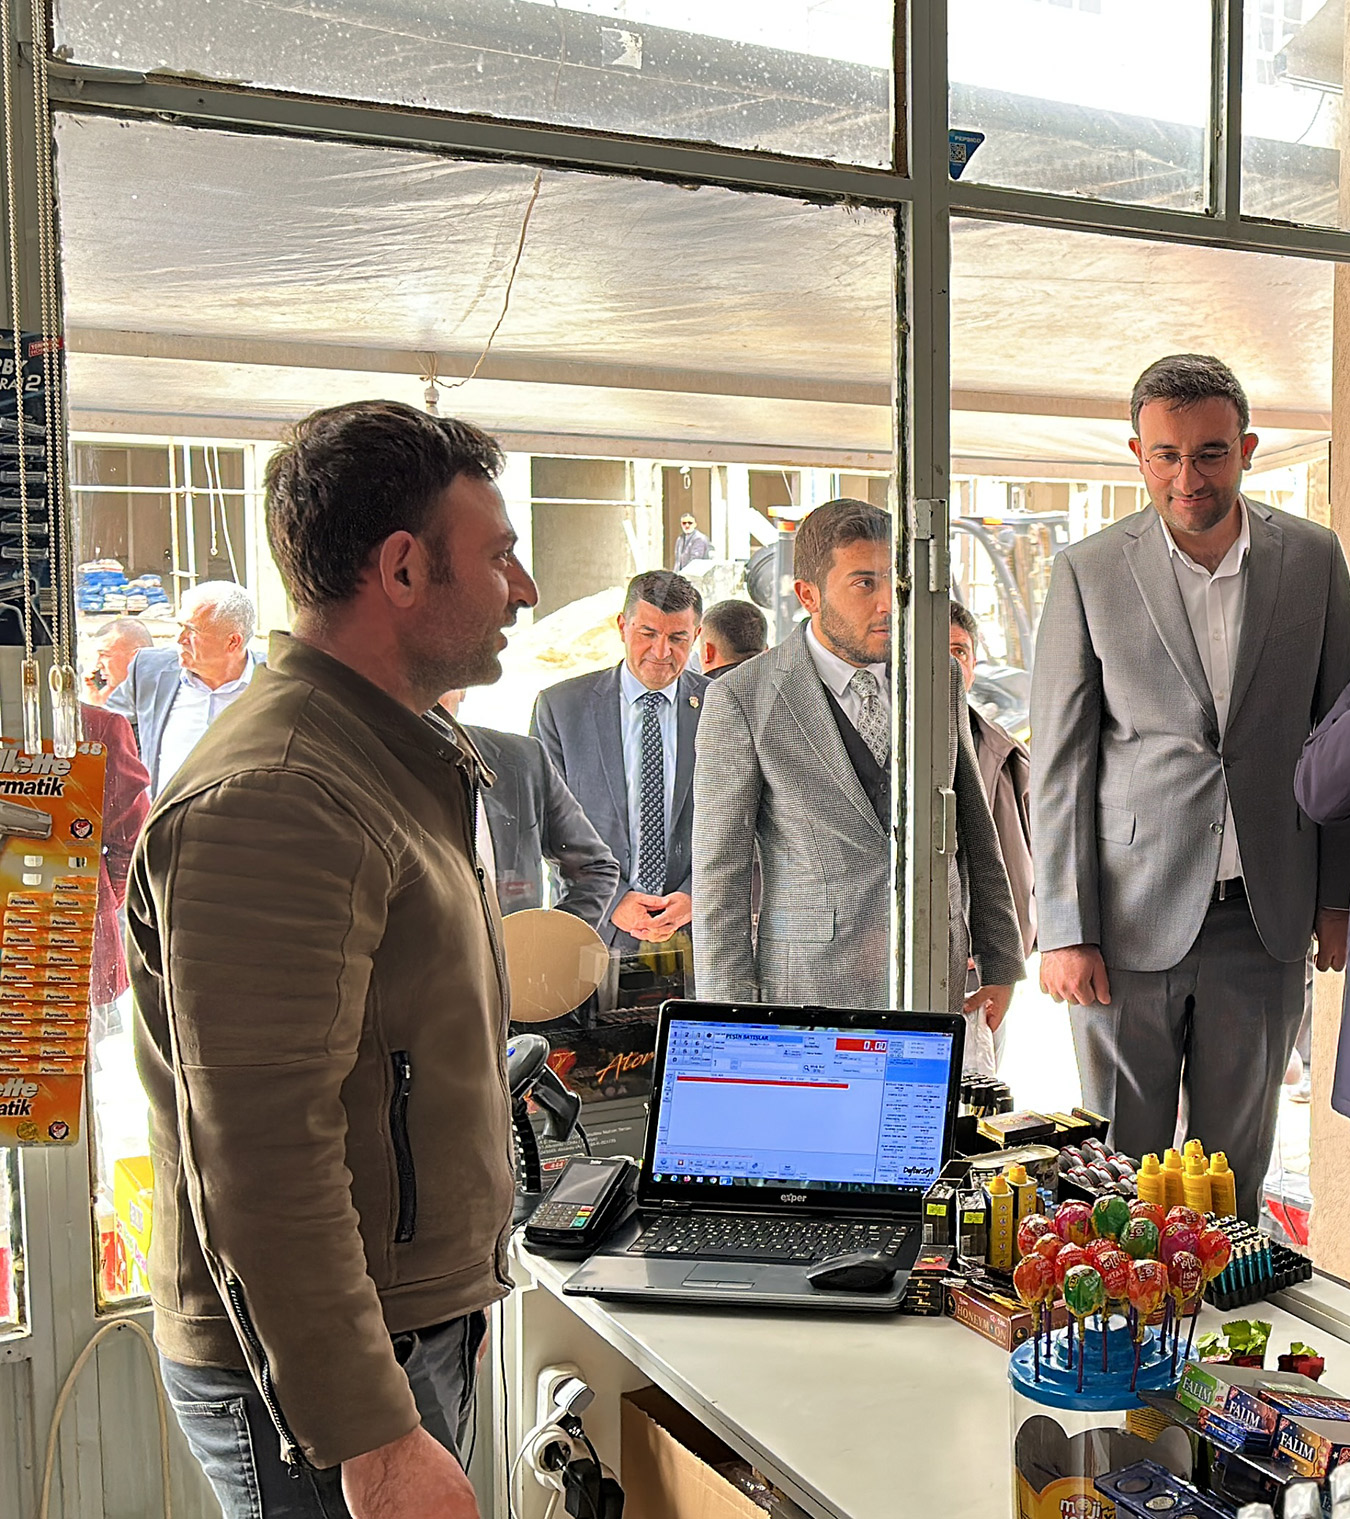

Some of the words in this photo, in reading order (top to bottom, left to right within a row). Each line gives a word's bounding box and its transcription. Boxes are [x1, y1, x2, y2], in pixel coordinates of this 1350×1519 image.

[78, 743, 102, 755] 48
[1182, 1377, 1212, 1404] FALIM
[1228, 1400, 1261, 1428] FALIM
[1280, 1431, 1314, 1462] FALIM
